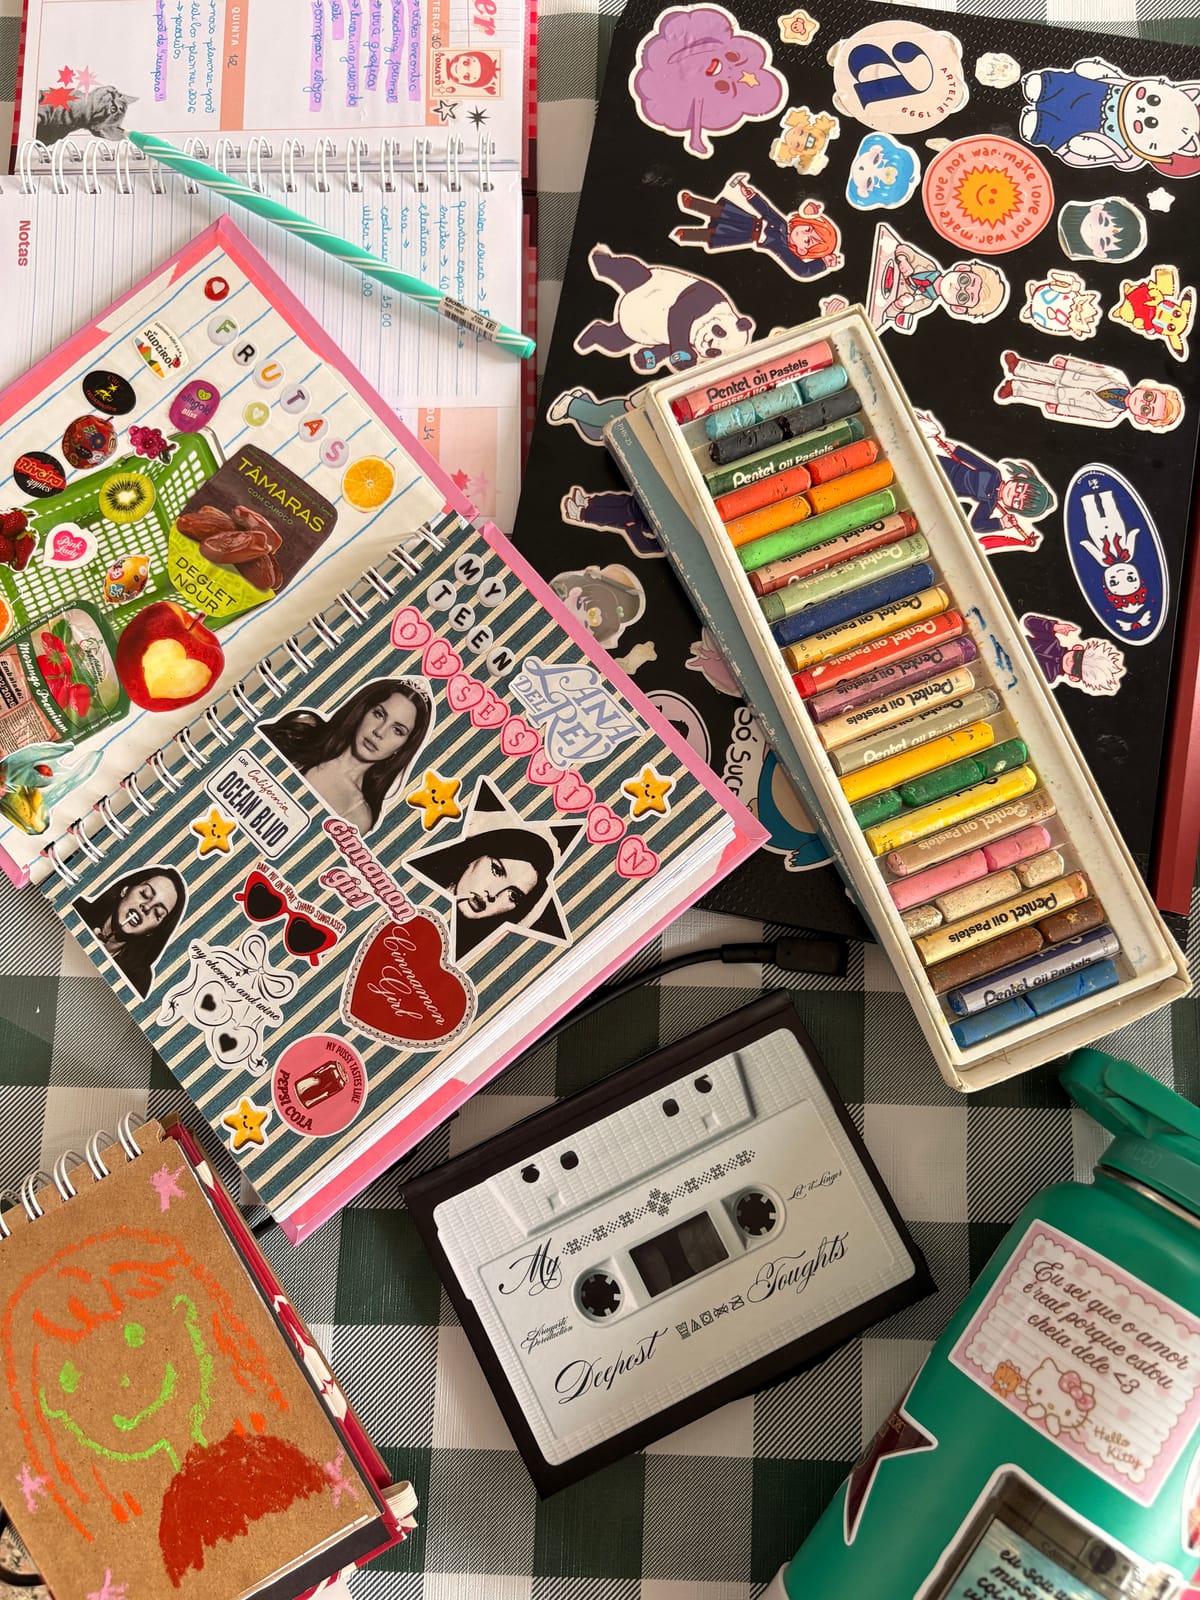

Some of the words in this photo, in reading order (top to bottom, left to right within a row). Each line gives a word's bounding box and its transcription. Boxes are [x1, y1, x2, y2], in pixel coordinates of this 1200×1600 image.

[231, 6, 240, 45] QUINTA
[946, 151, 966, 175] not
[1002, 151, 1036, 183] make
[934, 175, 949, 208] love
[1031, 184, 1043, 217] love
[941, 209, 975, 242] make
[1010, 219, 1034, 241] not
[17, 219, 31, 267] Notas
[706, 377, 751, 403] Pentel
[753, 372, 767, 386] Oil
[770, 359, 809, 379] Pastels
[181, 392, 213, 417] Jingold
[181, 408, 197, 419] Bliss
[732, 462, 775, 489] Pentel
[778, 456, 793, 470] Oil
[796, 445, 834, 464] Pastels
[26, 478, 50, 493] apples
[238, 457, 326, 533] TÂMARAS
[248, 486, 264, 503] COM
[57, 535, 82, 550] Pink
[58, 545, 79, 560] Lady
[173, 574, 219, 614] NOUR
[175, 556, 237, 607] DEGLET
[458, 559, 501, 599] MY
[859, 614, 874, 626] Oil
[878, 596, 922, 616] Pentel
[434, 585, 512, 672] TEEN
[815, 620, 857, 641] Pastels
[874, 638, 888, 651] Oil
[892, 620, 936, 645] Pentel
[830, 646, 871, 666] Pastels
[901, 649, 944, 675] Pentel
[18, 642, 42, 690] Morango
[36, 687, 69, 734] Premium
[837, 675, 876, 694] Pastels
[879, 667, 894, 679] Oil
[514, 677, 544, 713] DEL
[525, 659, 643, 745] LANA
[890, 697, 905, 709] Oil
[910, 678, 954, 706] Pentel
[533, 691, 611, 767] REY
[846, 703, 886, 725] Pastels
[238, 755, 249, 767] LDR
[863, 738, 907, 765] Pentel
[216, 770, 250, 820] OCEAN
[249, 798, 289, 848] BLVD
[247, 769, 290, 817] California
[984, 802, 1029, 827] Pentel
[918, 830, 960, 850] Pastels
[323, 819, 415, 921] cinnamon
[257, 863, 269, 876] BABY
[268, 868, 277, 882] PUT
[274, 877, 284, 890] ON
[283, 884, 298, 904] HEART
[314, 908, 345, 933] SUNGLASSES
[321, 868, 374, 908] girl
[992, 913, 1009, 927] Oil
[1013, 892, 1057, 920] Pentel
[948, 921, 991, 943] Pastels
[191, 943, 206, 960] my
[238, 986, 259, 1007] and
[258, 1003, 280, 1022] wine
[383, 926, 447, 1026] Cinnamon
[983, 976, 1029, 1006] Pentel
[1032, 970, 1049, 986] Oil
[1050, 955, 1093, 978] Pastels
[367, 965, 423, 1024] Girl
[326, 1041, 339, 1052] MY
[336, 1044, 355, 1066] PUSSY
[346, 1060, 363, 1088] TASTES
[275, 1069, 294, 1115] PEPSI
[286, 1106, 312, 1131] COLA
[350, 1086, 363, 1104] LIKE
[498, 1238, 563, 1297] My
[747, 1232, 850, 1305] Toughts
[1033, 1260, 1064, 1288] Eu
[1063, 1282, 1087, 1304] sei
[1086, 1298, 1122, 1326] que
[1122, 1318, 1139, 1333] o
[1136, 1328, 1190, 1371] amor
[1022, 1282, 1035, 1294] é
[1032, 1290, 1064, 1315] real
[1059, 1308, 1126, 1357] porque
[1125, 1351, 1174, 1391] estou
[1027, 1312, 1071, 1349] cheia
[1071, 1340, 1109, 1375] dele
[554, 1328, 668, 1405] Deepest
[1092, 1425, 1131, 1448] Hello
[1107, 1446, 1143, 1470] Kitty
[1000, 1549, 1022, 1568] eu
[1023, 1567, 1054, 1593] sou
